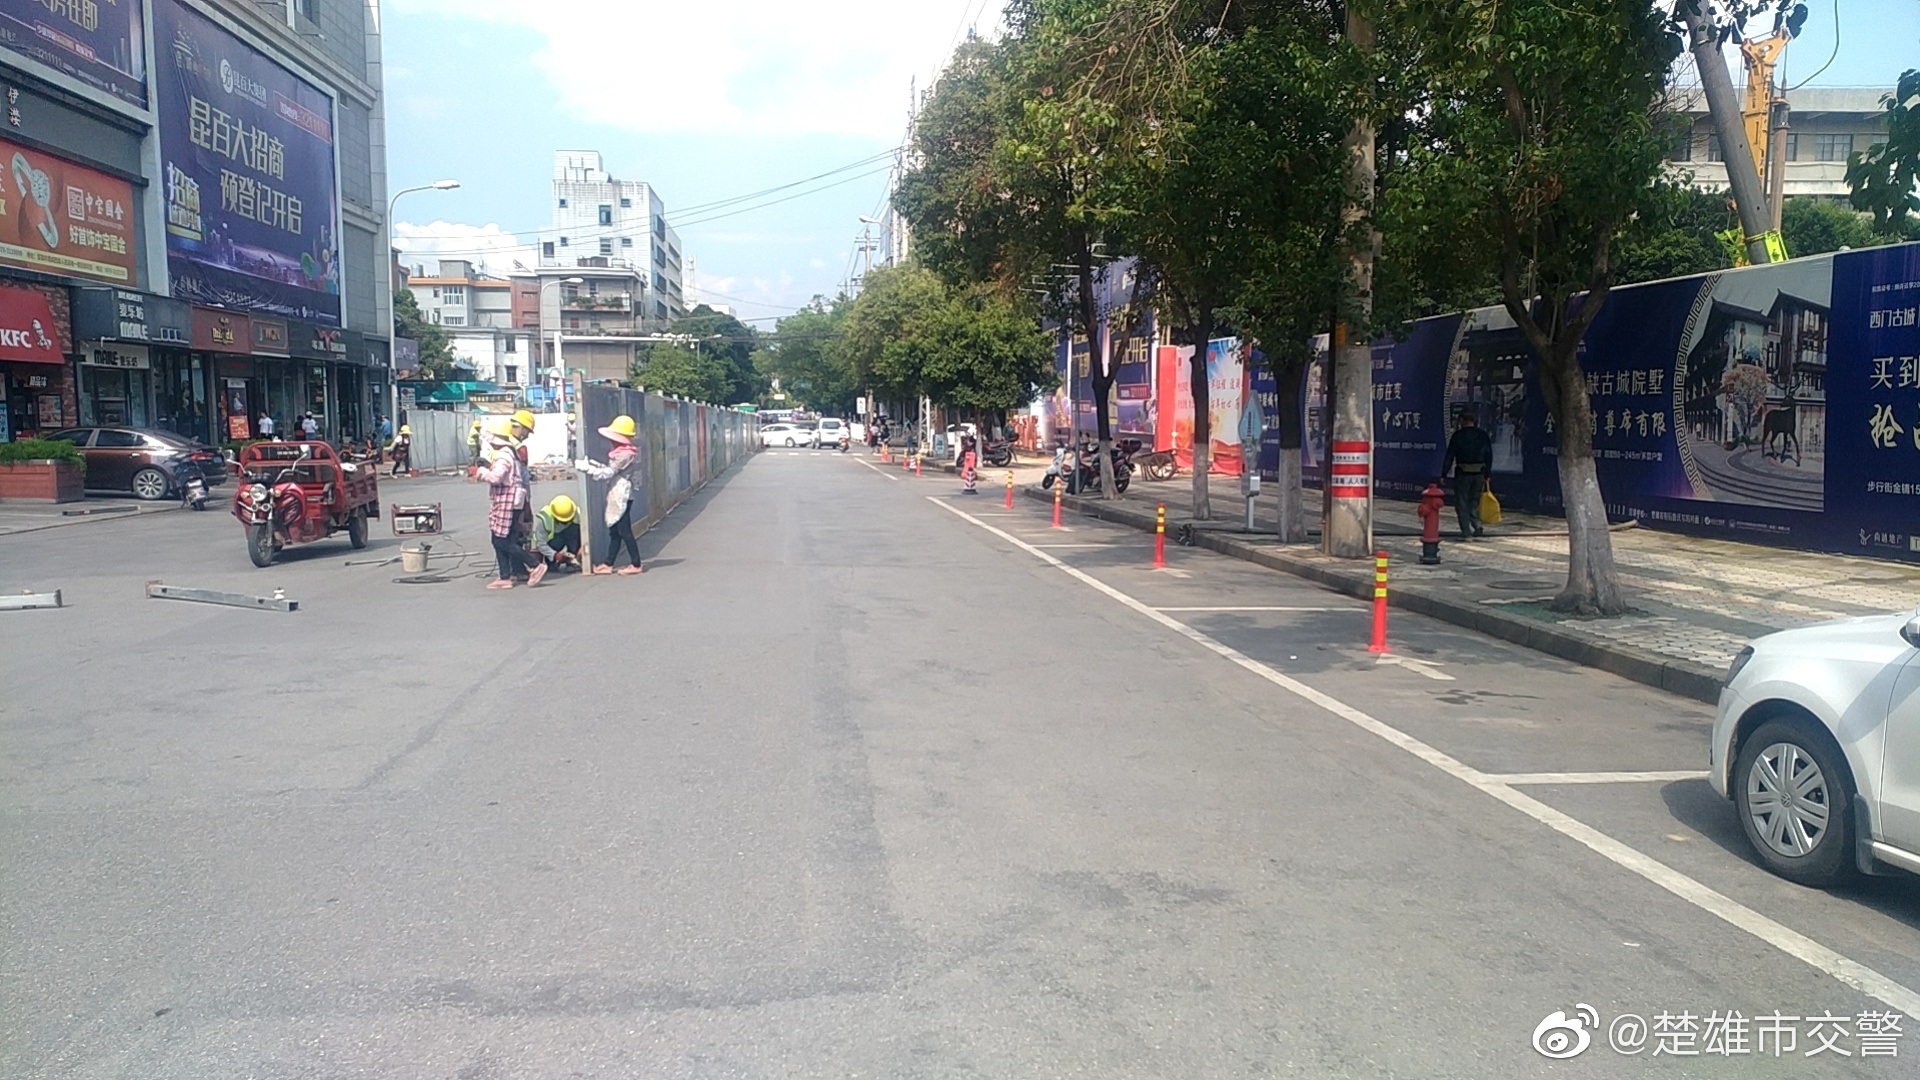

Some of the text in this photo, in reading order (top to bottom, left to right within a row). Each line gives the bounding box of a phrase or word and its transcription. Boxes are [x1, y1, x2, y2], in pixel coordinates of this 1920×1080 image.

[233, 70, 267, 103] 昆百大集团
[189, 95, 284, 182] 昆百大招商
[167, 161, 200, 213] 招商
[220, 168, 302, 235] 预登记开启
[85, 192, 124, 220] 中宝国金
[69, 224, 126, 254] 好首饰中宝国金
[118, 303, 145, 321] 麦乐坊
[1870, 307, 1915, 328] 西门古城
[0, 328, 32, 349] KFC
[1869, 354, 1920, 391] 买到
[1382, 407, 1421, 431] 中心不变
[1867, 480, 1920, 495] 步行街金铺15
